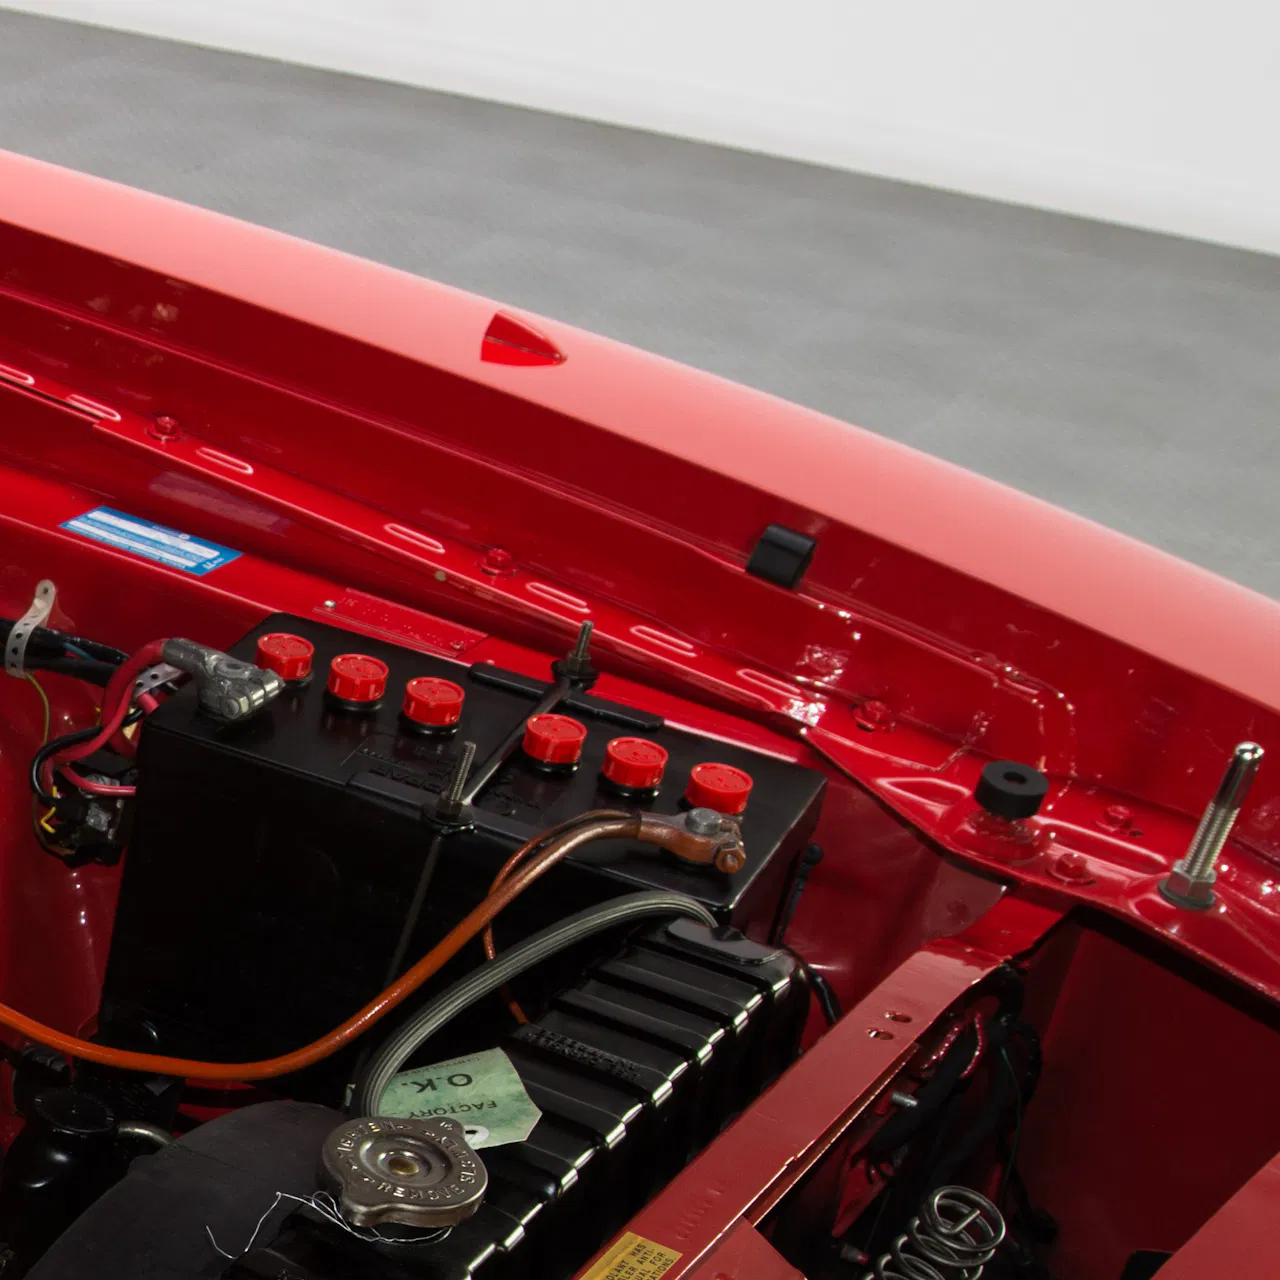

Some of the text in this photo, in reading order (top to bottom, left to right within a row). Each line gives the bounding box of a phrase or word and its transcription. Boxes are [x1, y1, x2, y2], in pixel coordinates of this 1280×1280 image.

[401, 1073, 473, 1094] O.K.
[409, 1100, 498, 1118] FACTORY
[630, 1243, 647, 1257] HAS
[650, 1251, 667, 1267] FOR
